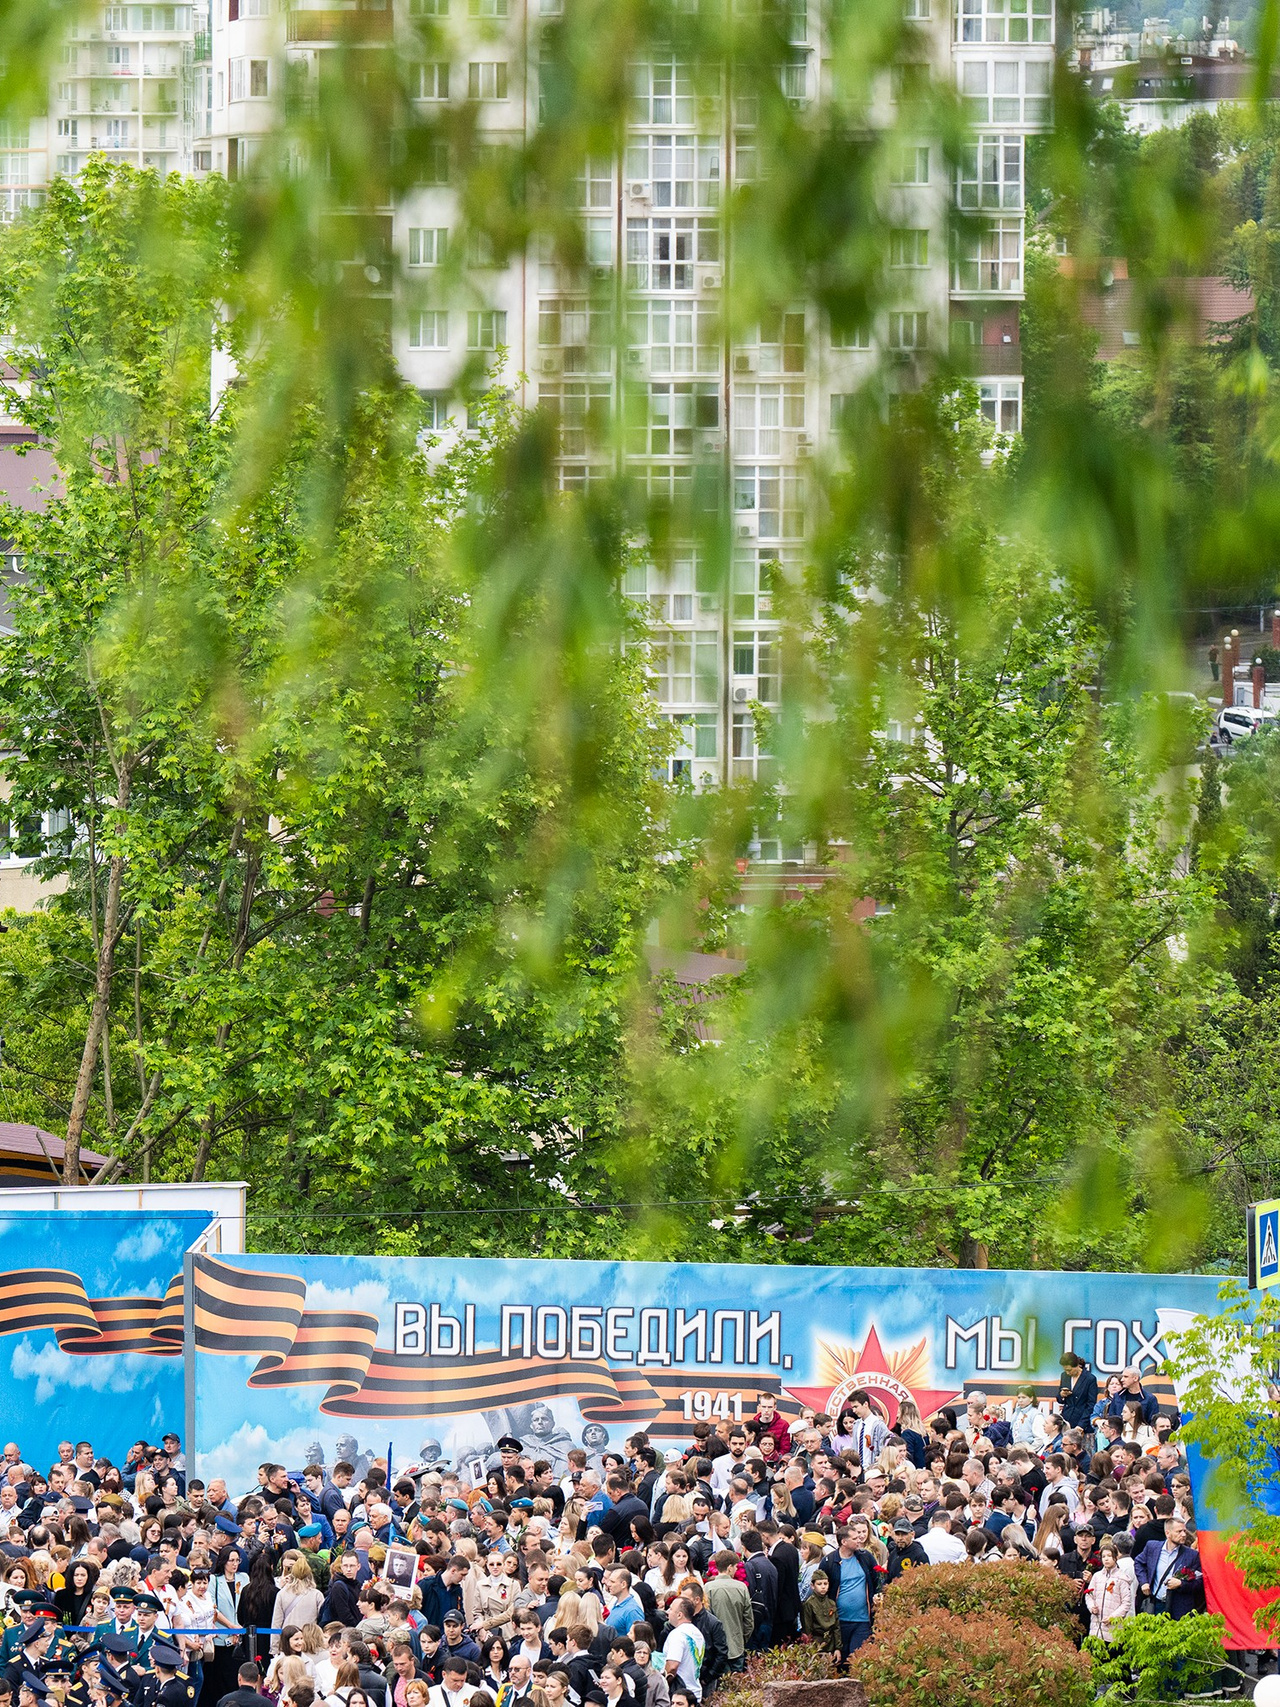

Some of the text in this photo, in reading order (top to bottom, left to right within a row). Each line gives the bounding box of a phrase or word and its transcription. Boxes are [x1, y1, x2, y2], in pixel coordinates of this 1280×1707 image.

[394, 1302, 475, 1357] ВЫ
[945, 1314, 1037, 1371] МЫ
[679, 1391, 743, 1422] 1941
